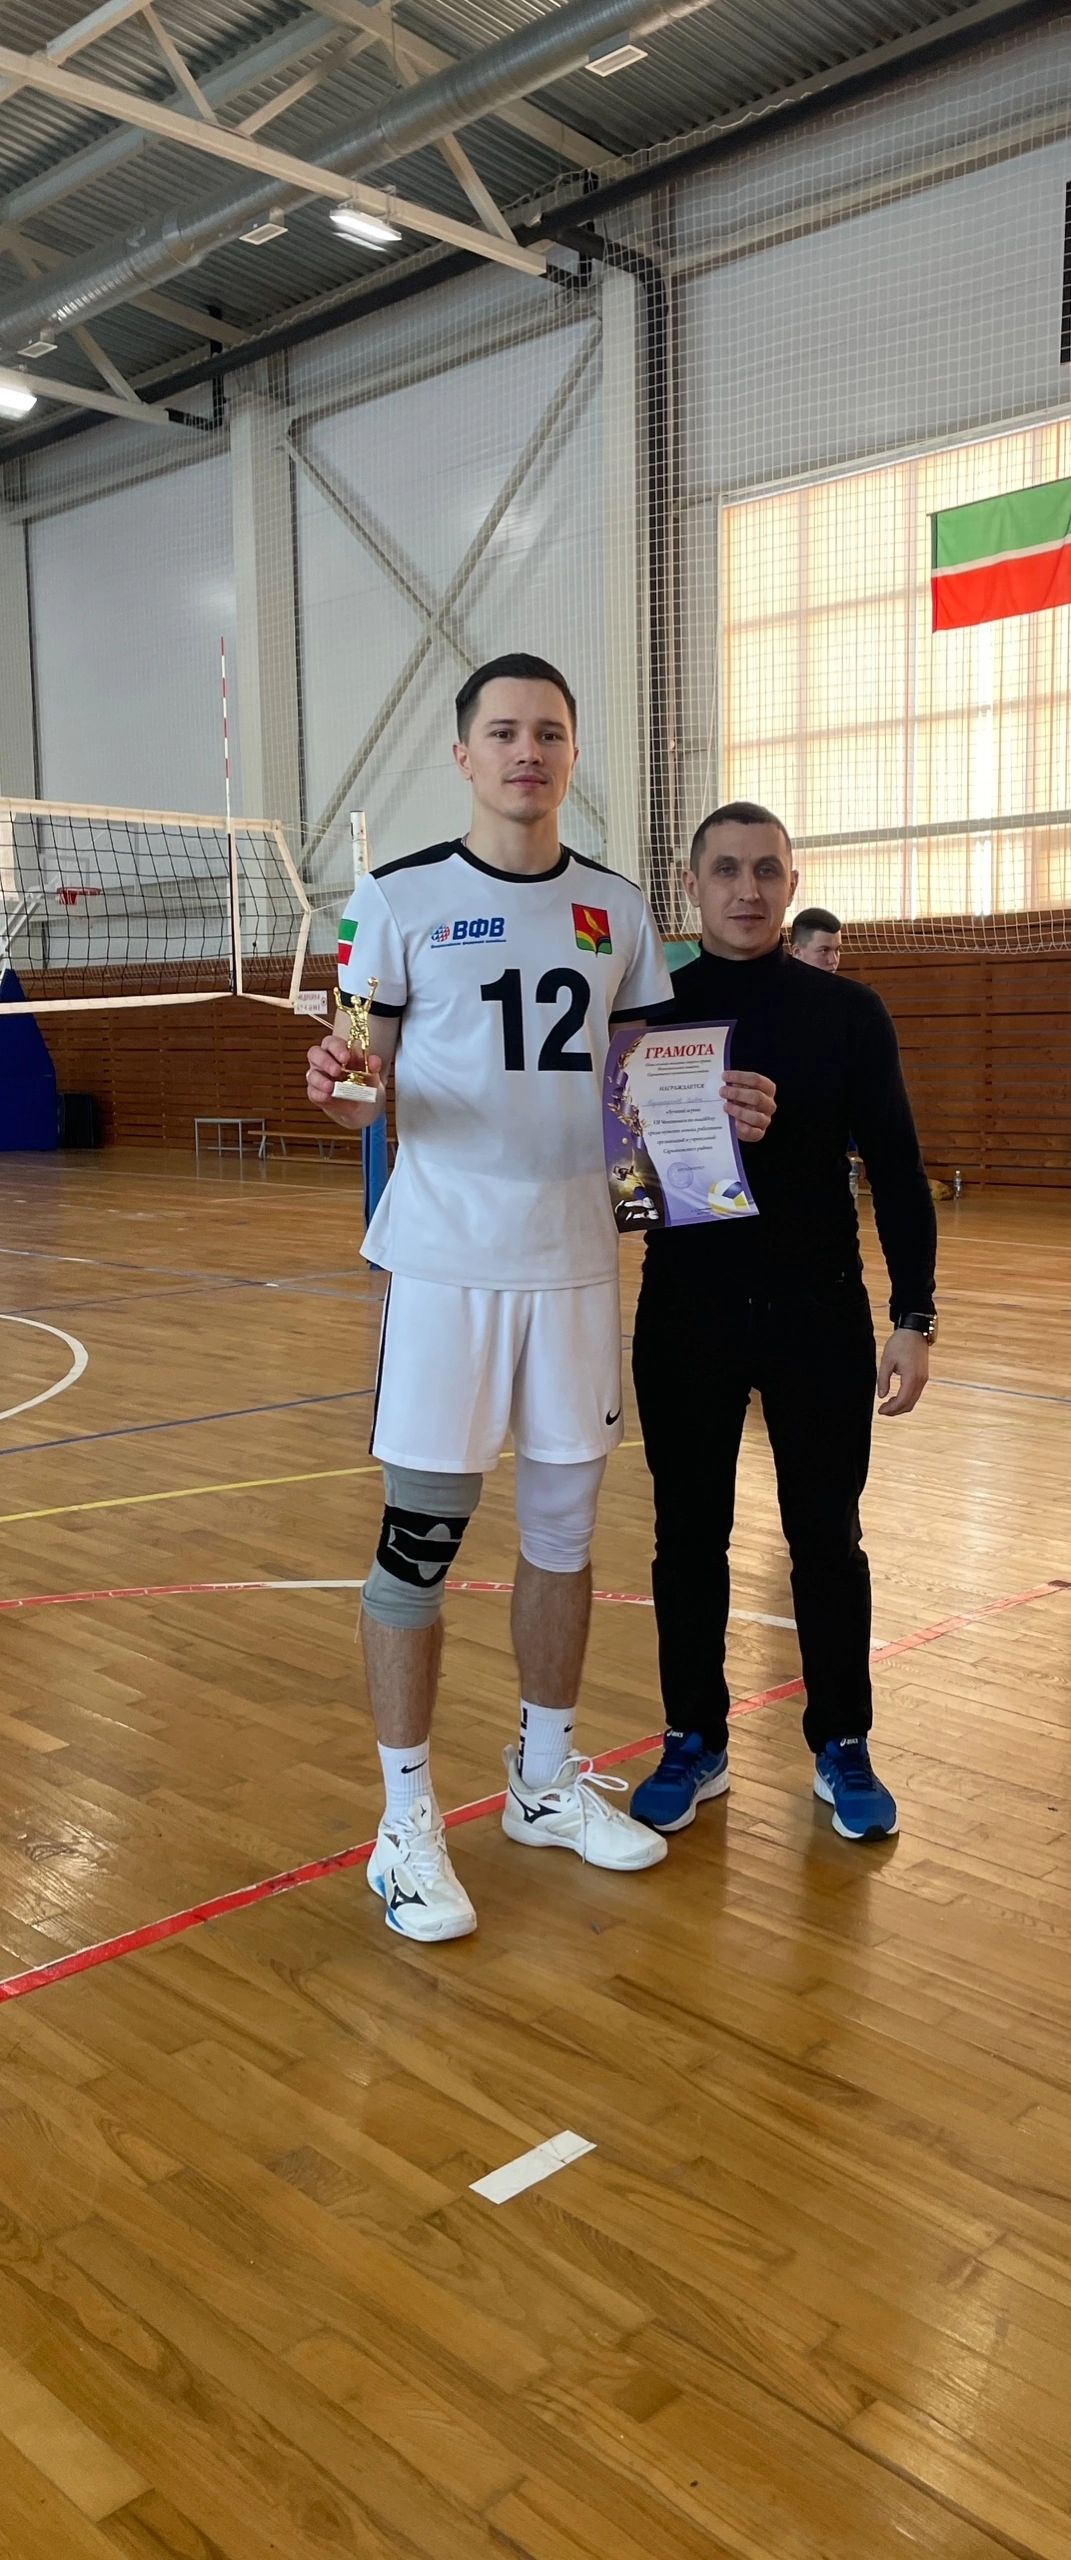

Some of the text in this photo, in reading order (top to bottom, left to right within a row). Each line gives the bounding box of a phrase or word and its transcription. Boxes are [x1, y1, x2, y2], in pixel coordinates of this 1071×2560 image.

[453, 917, 505, 940] ВФВ
[480, 967, 593, 1072] 12
[645, 1043, 715, 1059] ГРАМОТА
